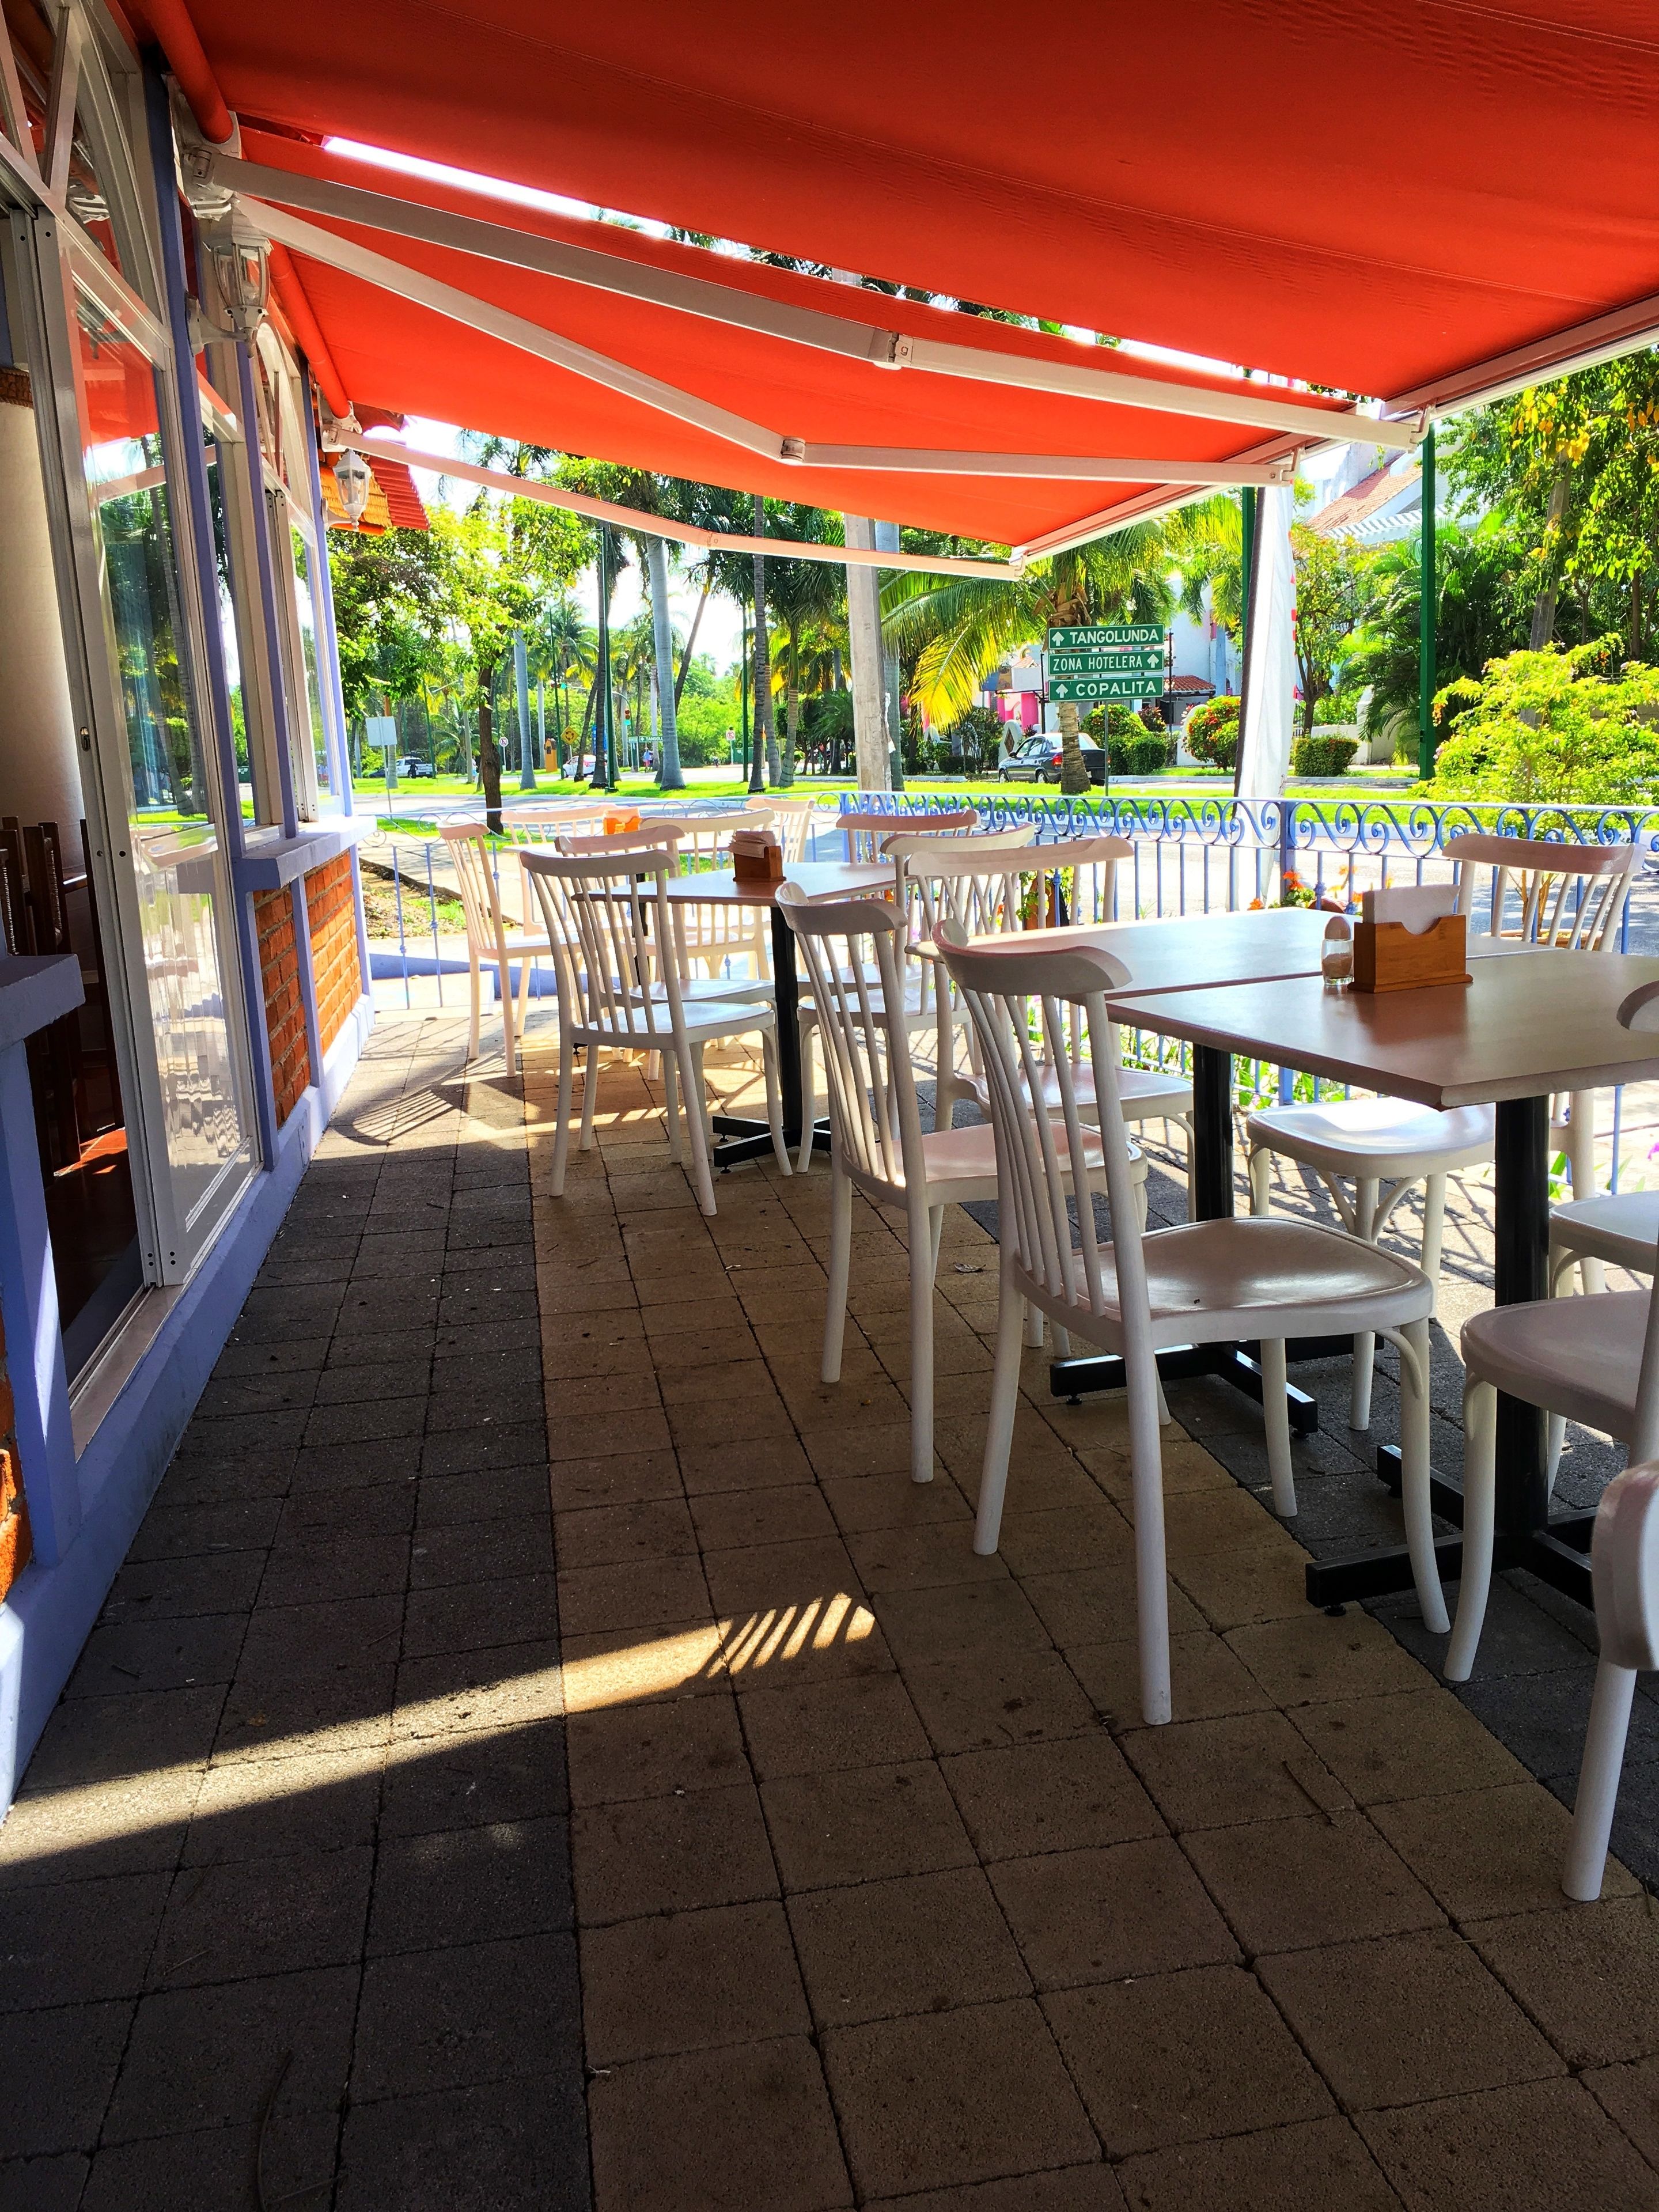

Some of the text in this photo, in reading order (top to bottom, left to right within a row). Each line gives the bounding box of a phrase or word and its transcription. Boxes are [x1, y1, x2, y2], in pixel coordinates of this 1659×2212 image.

[1070, 628, 1159, 645] TANGOLUNDA
[1053, 655, 1143, 672] ZONA HOTELERA
[1075, 680, 1157, 696] COPALITA
